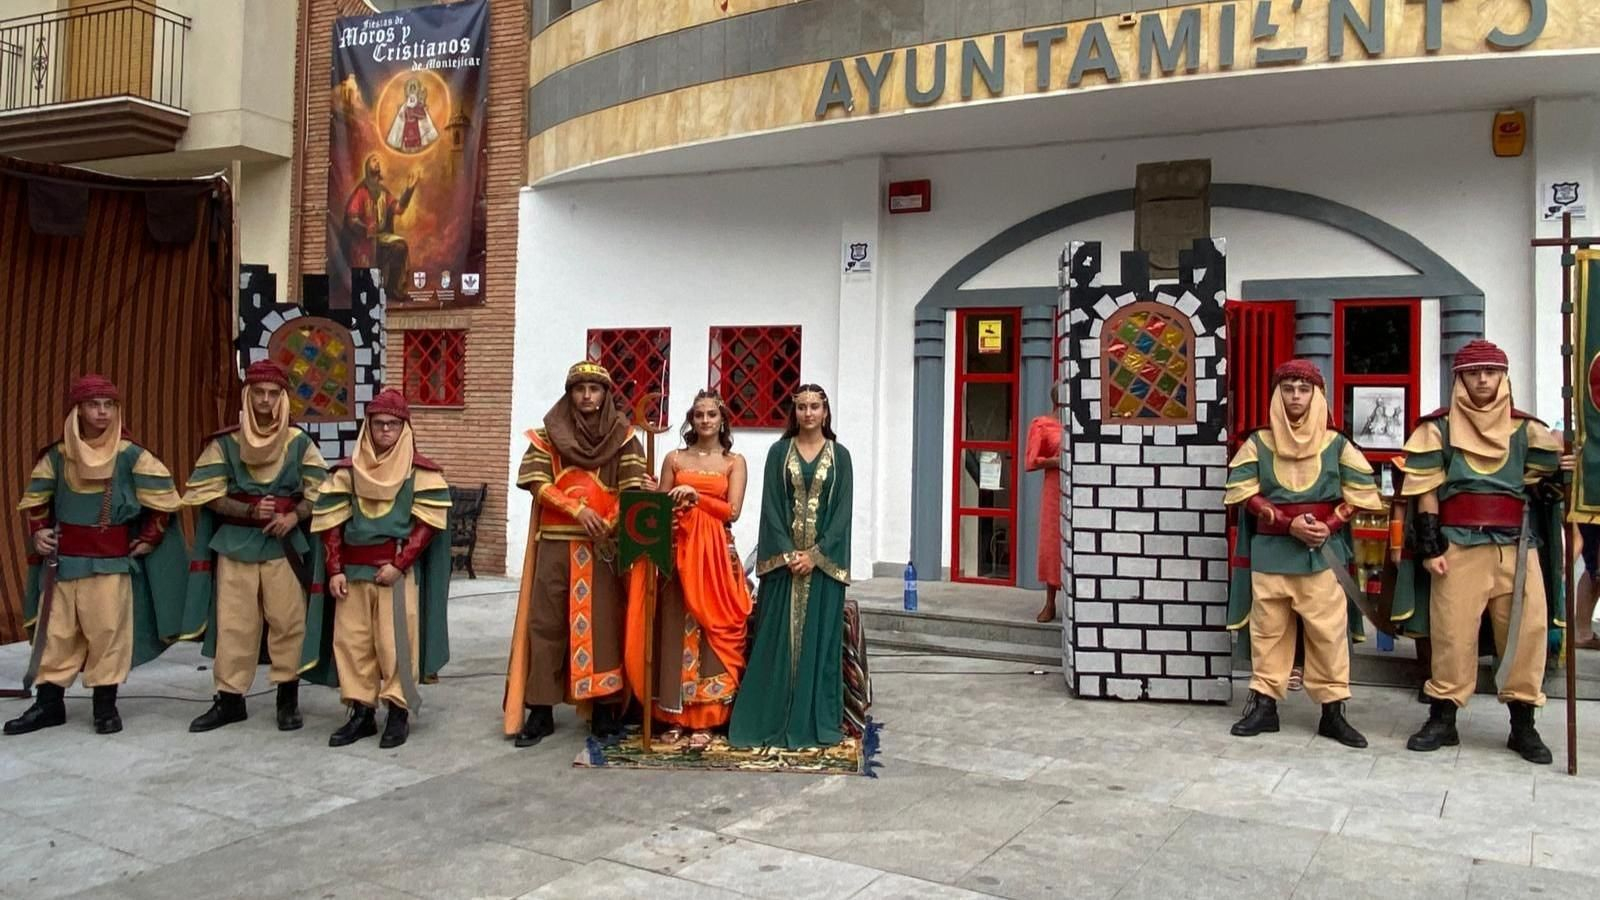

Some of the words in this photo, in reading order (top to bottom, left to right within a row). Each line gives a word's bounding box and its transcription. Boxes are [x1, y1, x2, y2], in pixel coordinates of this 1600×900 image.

[362, 18, 392, 31] Fiestas
[394, 15, 404, 25] de
[339, 27, 394, 48] Moros
[402, 25, 411, 44] y
[373, 37, 470, 62] Cristianos
[411, 60, 423, 71] de
